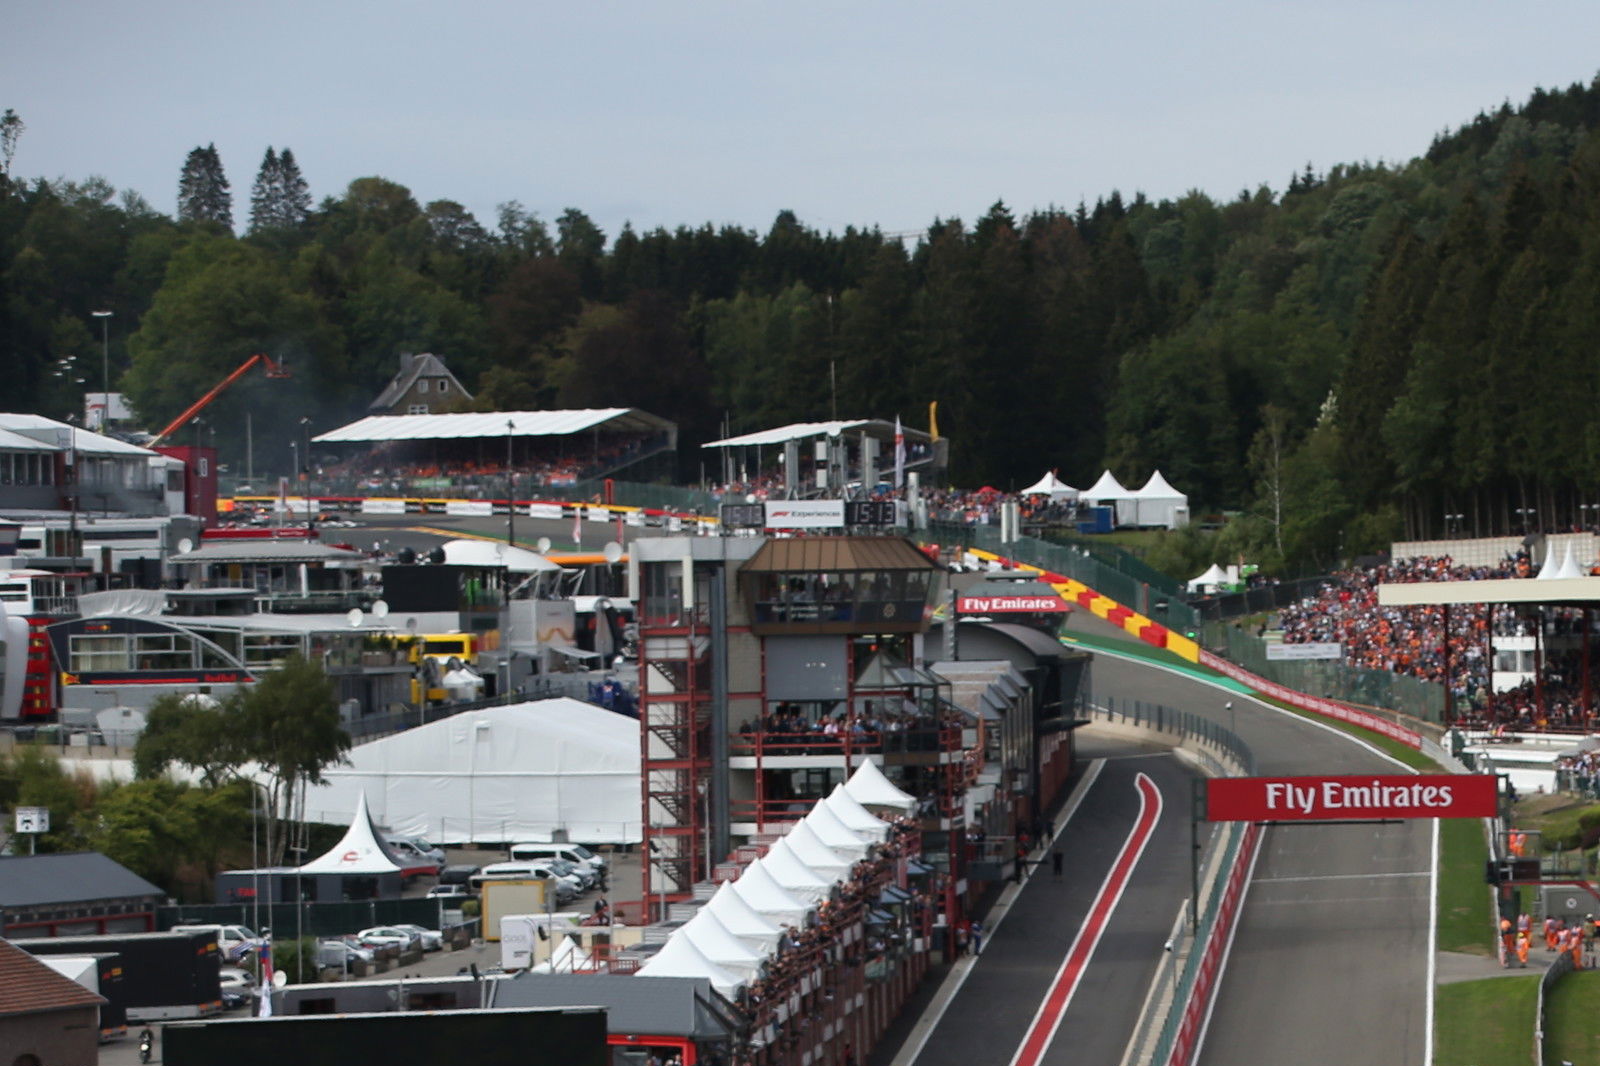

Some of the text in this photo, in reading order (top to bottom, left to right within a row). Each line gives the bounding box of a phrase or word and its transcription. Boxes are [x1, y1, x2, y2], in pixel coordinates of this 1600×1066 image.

[854, 503, 894, 523] 15:13
[964, 597, 1056, 611] Fly Emirates
[1266, 780, 1453, 814] Fly Emirates
